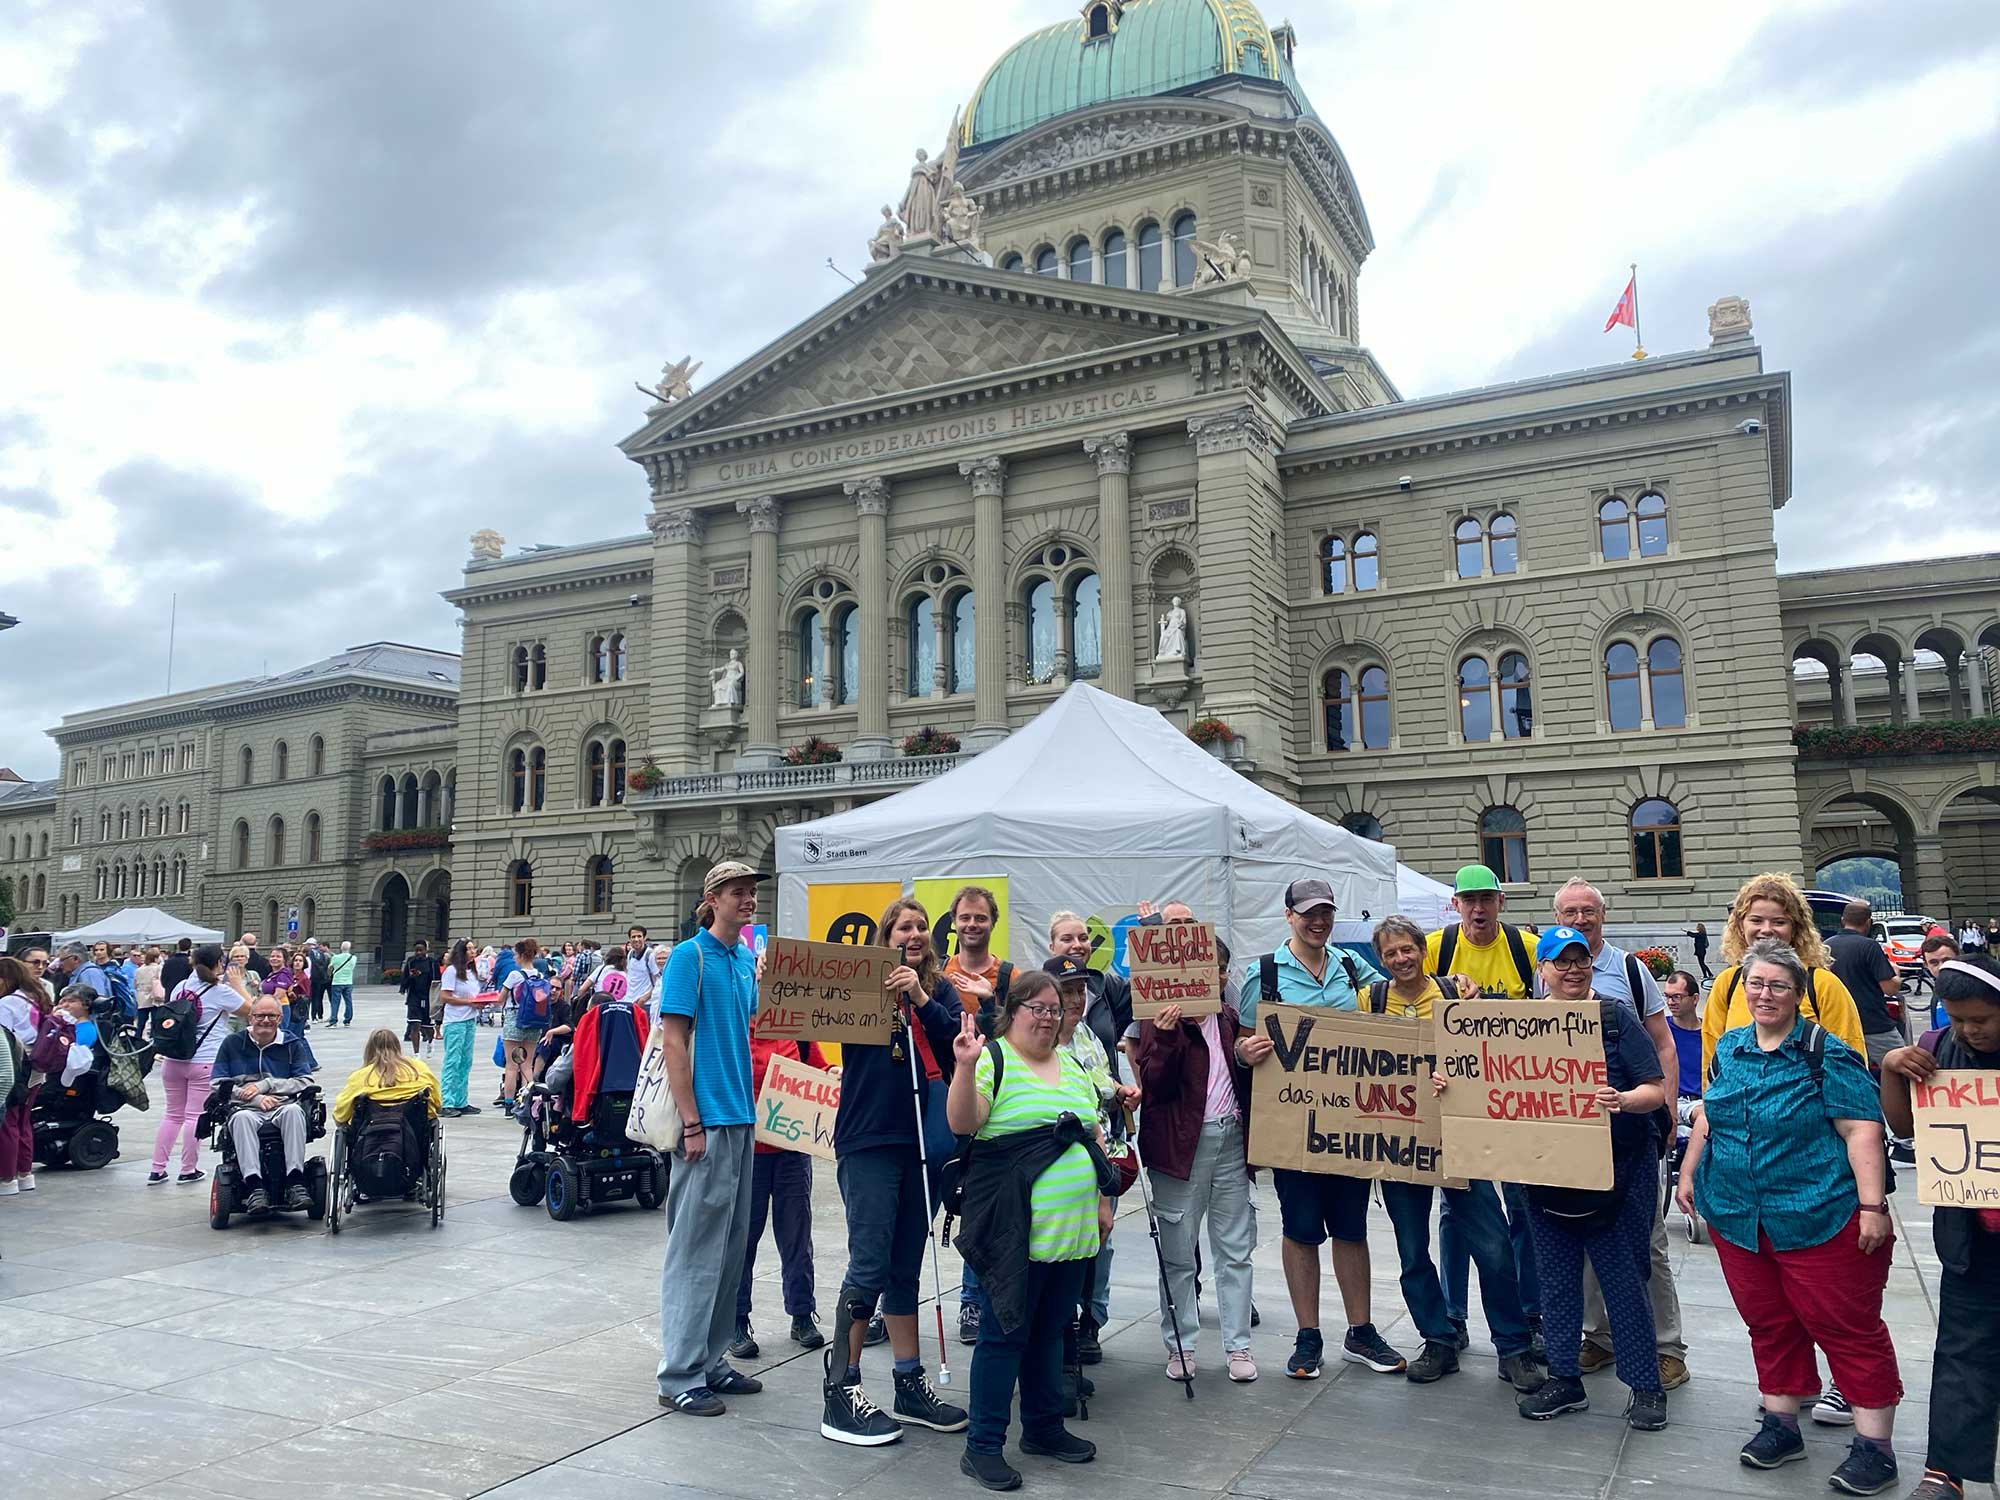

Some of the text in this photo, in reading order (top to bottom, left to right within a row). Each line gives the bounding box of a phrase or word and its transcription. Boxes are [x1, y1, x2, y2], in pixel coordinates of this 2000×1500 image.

[719, 385, 1157, 482] CURIA CONFOEDERATIONIS HELVETICAE
[826, 849, 868, 859] Stadt Bern
[772, 942, 871, 980] Inklusion
[1128, 926, 1214, 971] Vielfalt
[769, 981, 851, 1006] geht uns
[756, 1008, 806, 1029] ALLE
[1443, 1002, 1599, 1047] Gemeinsam für
[1444, 1040, 1608, 1086] eine INKLUSIVE
[1321, 1092, 1350, 1109] was
[1355, 1082, 1417, 1117] UNS
[1931, 1180, 1999, 1205] 10 Jahre
